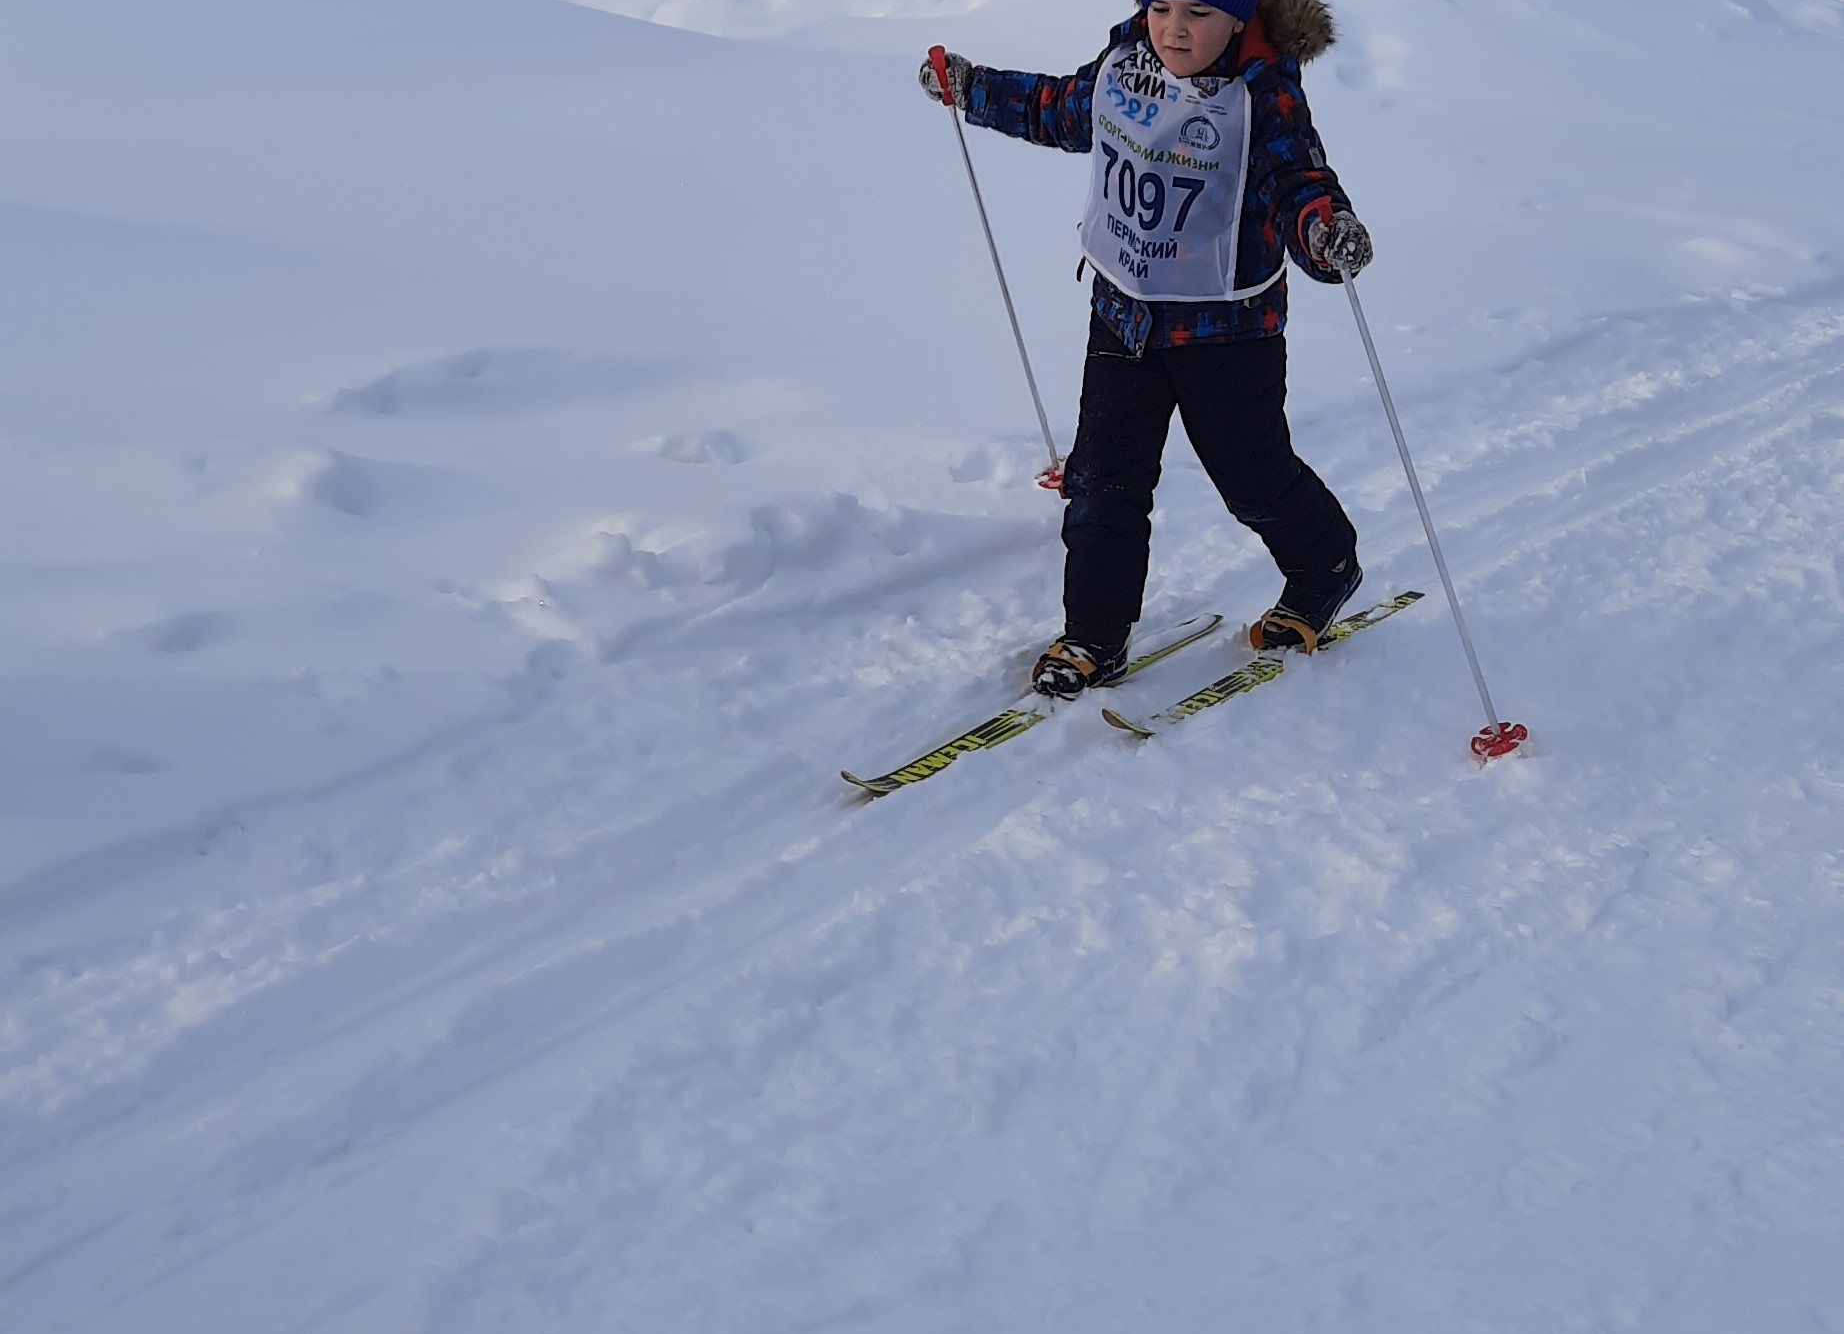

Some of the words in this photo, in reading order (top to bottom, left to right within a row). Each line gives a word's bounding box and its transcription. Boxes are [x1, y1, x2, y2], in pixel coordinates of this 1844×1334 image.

[1165, 150, 1220, 171] ЖИЗНИ
[1100, 140, 1206, 232] 7097
[1107, 212, 1178, 259] ПЕРМСКИЙ
[1118, 247, 1149, 279] КРАЙ
